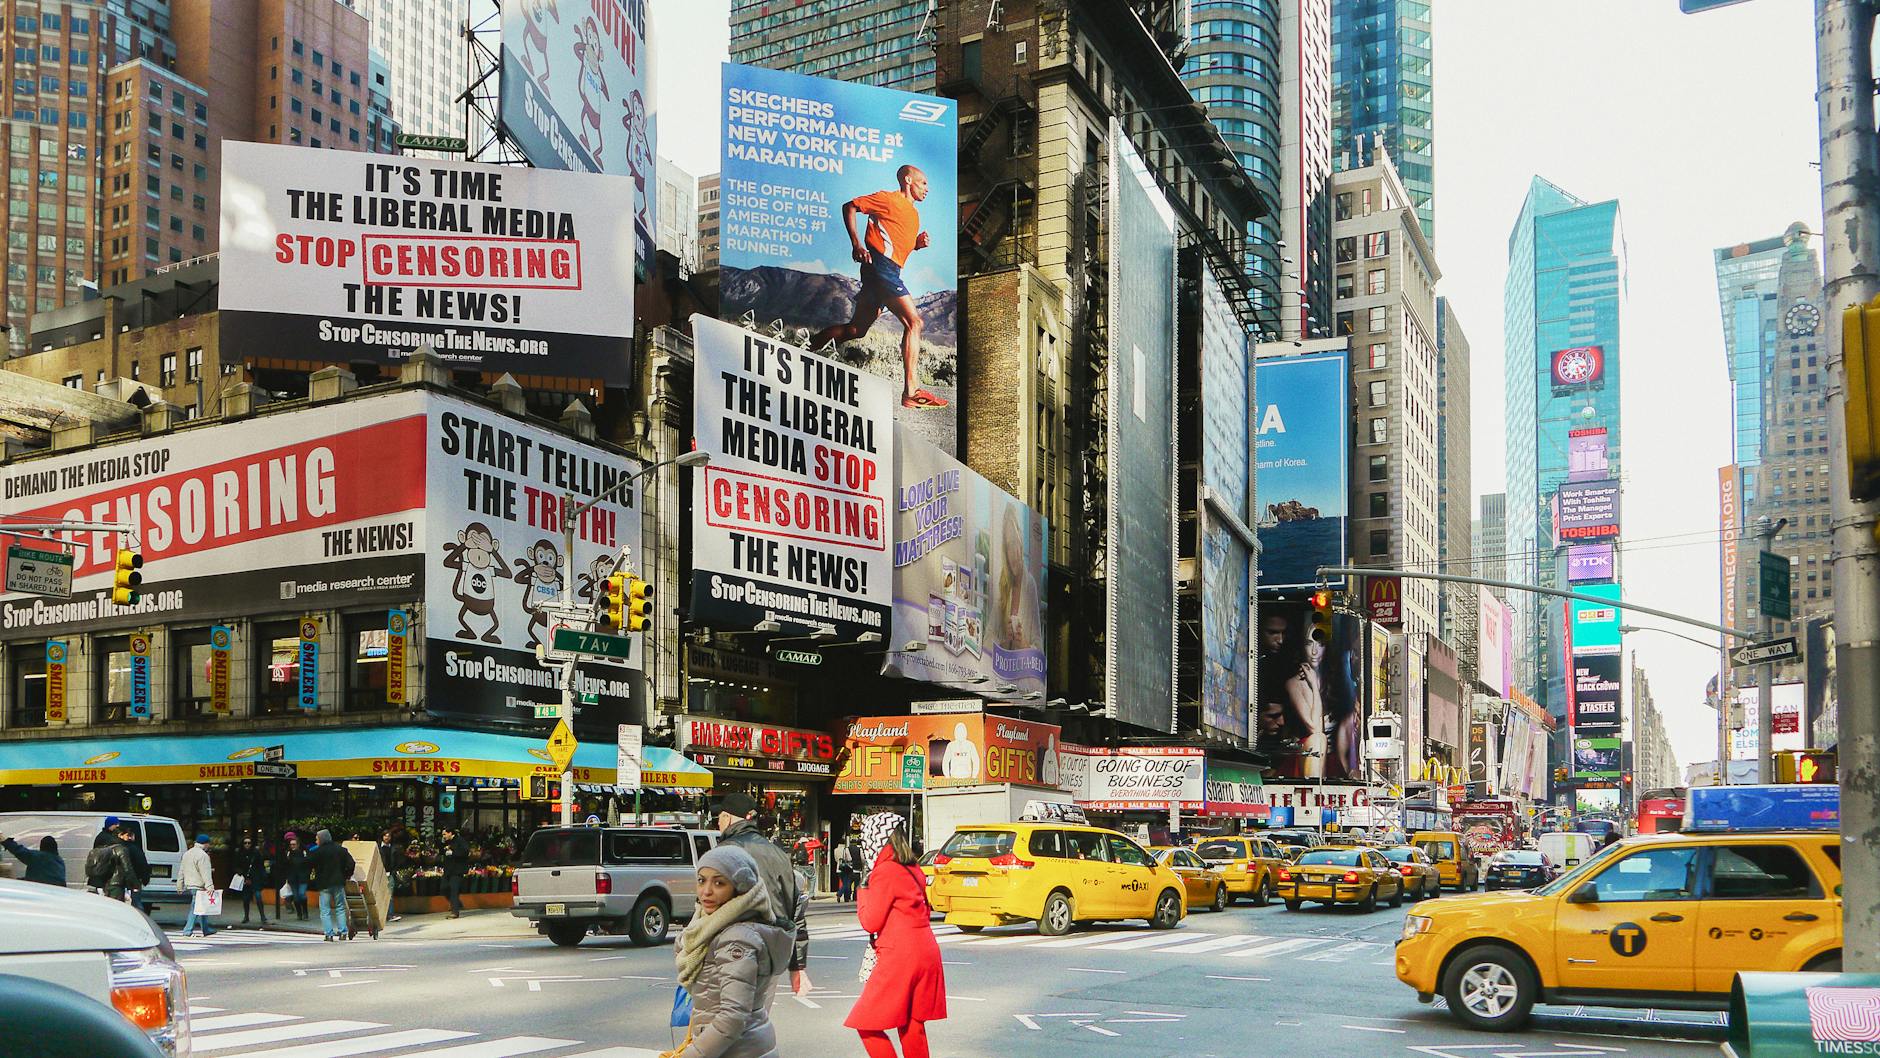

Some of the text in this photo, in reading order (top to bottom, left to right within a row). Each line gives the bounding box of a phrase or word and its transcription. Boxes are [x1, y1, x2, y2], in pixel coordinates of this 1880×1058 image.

[728, 87, 834, 119] SKECHERS
[728, 105, 904, 148] PERFORMANCE at
[402, 135, 460, 148] LAMAR
[728, 123, 895, 163] NEW YORK HALF
[728, 142, 844, 175] MARATHON
[365, 163, 502, 202] IT'S TIME
[727, 178, 829, 204] THE OFFICIAL
[287, 189, 576, 241] THE LIBERAL MEDIA
[727, 194, 832, 219] SHOE OF MEB.
[727, 208, 826, 233] AMERICA'S #1
[727, 222, 813, 245] MARATHON
[275, 233, 571, 280] STOP CENSORING
[727, 237, 793, 257] RUNNER.
[343, 283, 522, 325] THE NEWS!
[743, 335, 859, 408] IT'S TIME
[721, 371, 877, 454] THE LIBERAL
[1568, 427, 1607, 438] TOSHIBA
[441, 411, 634, 509] START TELLING
[722, 417, 876, 492] MEDIA STOP
[5, 448, 171, 500] DEMAND THE MEDIA STOP
[898, 469, 960, 512] LONG LIVE
[1563, 487, 1617, 498] Work Smarter
[1563, 495, 1611, 505] With Toshiba
[463, 469, 617, 548] THE TRUTH!
[713, 477, 880, 541] CENSORING
[915, 496, 948, 532] YOUR
[1563, 503, 1612, 514] The Managed
[1563, 512, 1613, 522] Print Experts
[322, 521, 414, 558] THE NEWS!
[894, 514, 963, 568] MATTRESS!
[1561, 525, 1619, 539] TOSHIBA
[19, 551, 65, 563] BIKE ROUTE
[729, 532, 868, 595] THE NEWS!
[1580, 556, 1609, 566] TDK
[16, 573, 63, 586] DO NOT PASS
[18, 582, 47, 592] SHARED
[49, 585, 69, 594] LANE
[297, 573, 413, 594] media research center
[471, 578, 486, 589] abc
[536, 585, 550, 595] CBS
[1375, 607, 1393, 617] 24
[579, 635, 587, 650] 7
[1740, 644, 1788, 661] ONE WAY
[391, 635, 403, 700] SMILER'S
[779, 651, 817, 664] LAMAR
[134, 656, 147, 714] SMILER'S
[213, 649, 226, 711] SMILER'S
[303, 643, 316, 706] SMILER'S
[1576, 680, 1620, 692] BLACK CROWN
[50, 663, 62, 719] SMILER'S
[691, 721, 833, 759] EMBASSY GIFTS
[848, 722, 909, 742] Playland
[996, 723, 1029, 744] Playland
[199, 763, 254, 778] SMILER'S
[372, 760, 461, 774] SMILER'S
[703, 754, 716, 765] NY
[797, 762, 830, 773] LUGGAGE
[987, 745, 1036, 781] GIFTS
[1096, 759, 1195, 773] GOING OUT OF
[58, 769, 107, 782] SMILER'S
[1108, 775, 1185, 788] BUSINESS
[1110, 789, 1150, 798] EVERYTHING
[1153, 789, 1170, 797] MUST
[1206, 774, 1235, 801] sbarro
[1240, 777, 1265, 804] sbarro
